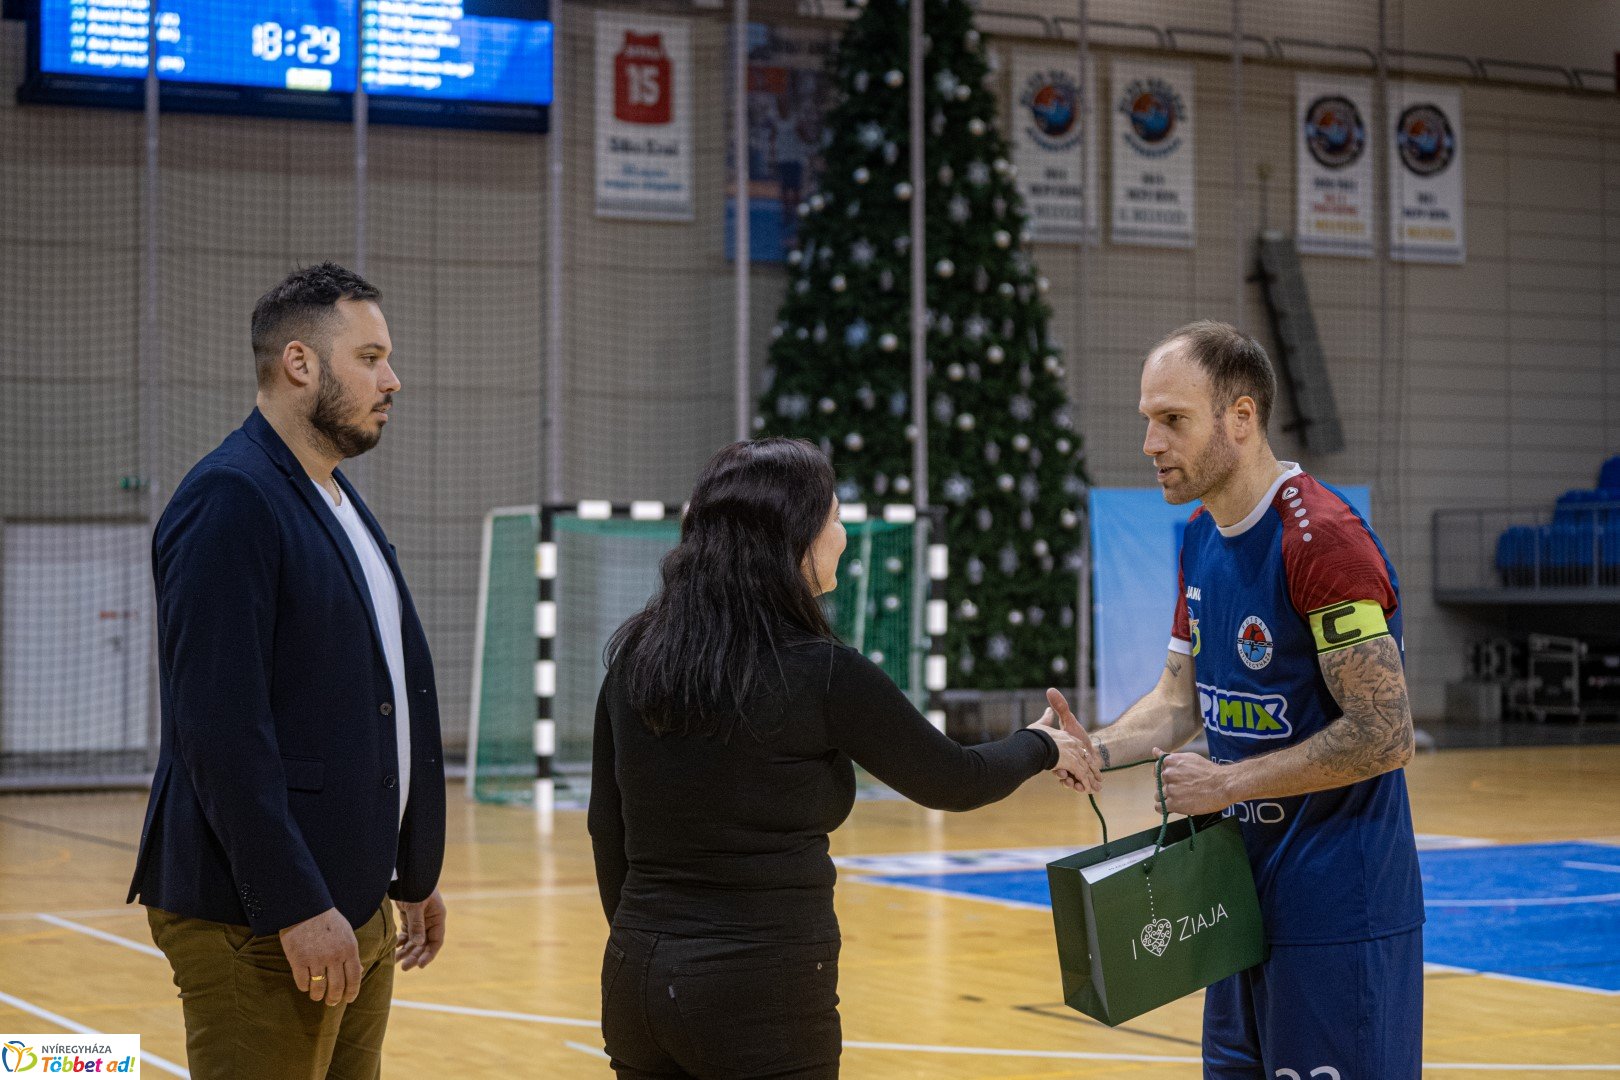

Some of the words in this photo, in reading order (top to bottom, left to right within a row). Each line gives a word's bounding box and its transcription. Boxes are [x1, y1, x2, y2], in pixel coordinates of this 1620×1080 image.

[251, 21, 341, 65] 18:29
[625, 63, 661, 106] 15
[1322, 605, 1362, 644] C
[1131, 939, 1137, 961] I
[1176, 902, 1229, 942] ZIAJA
